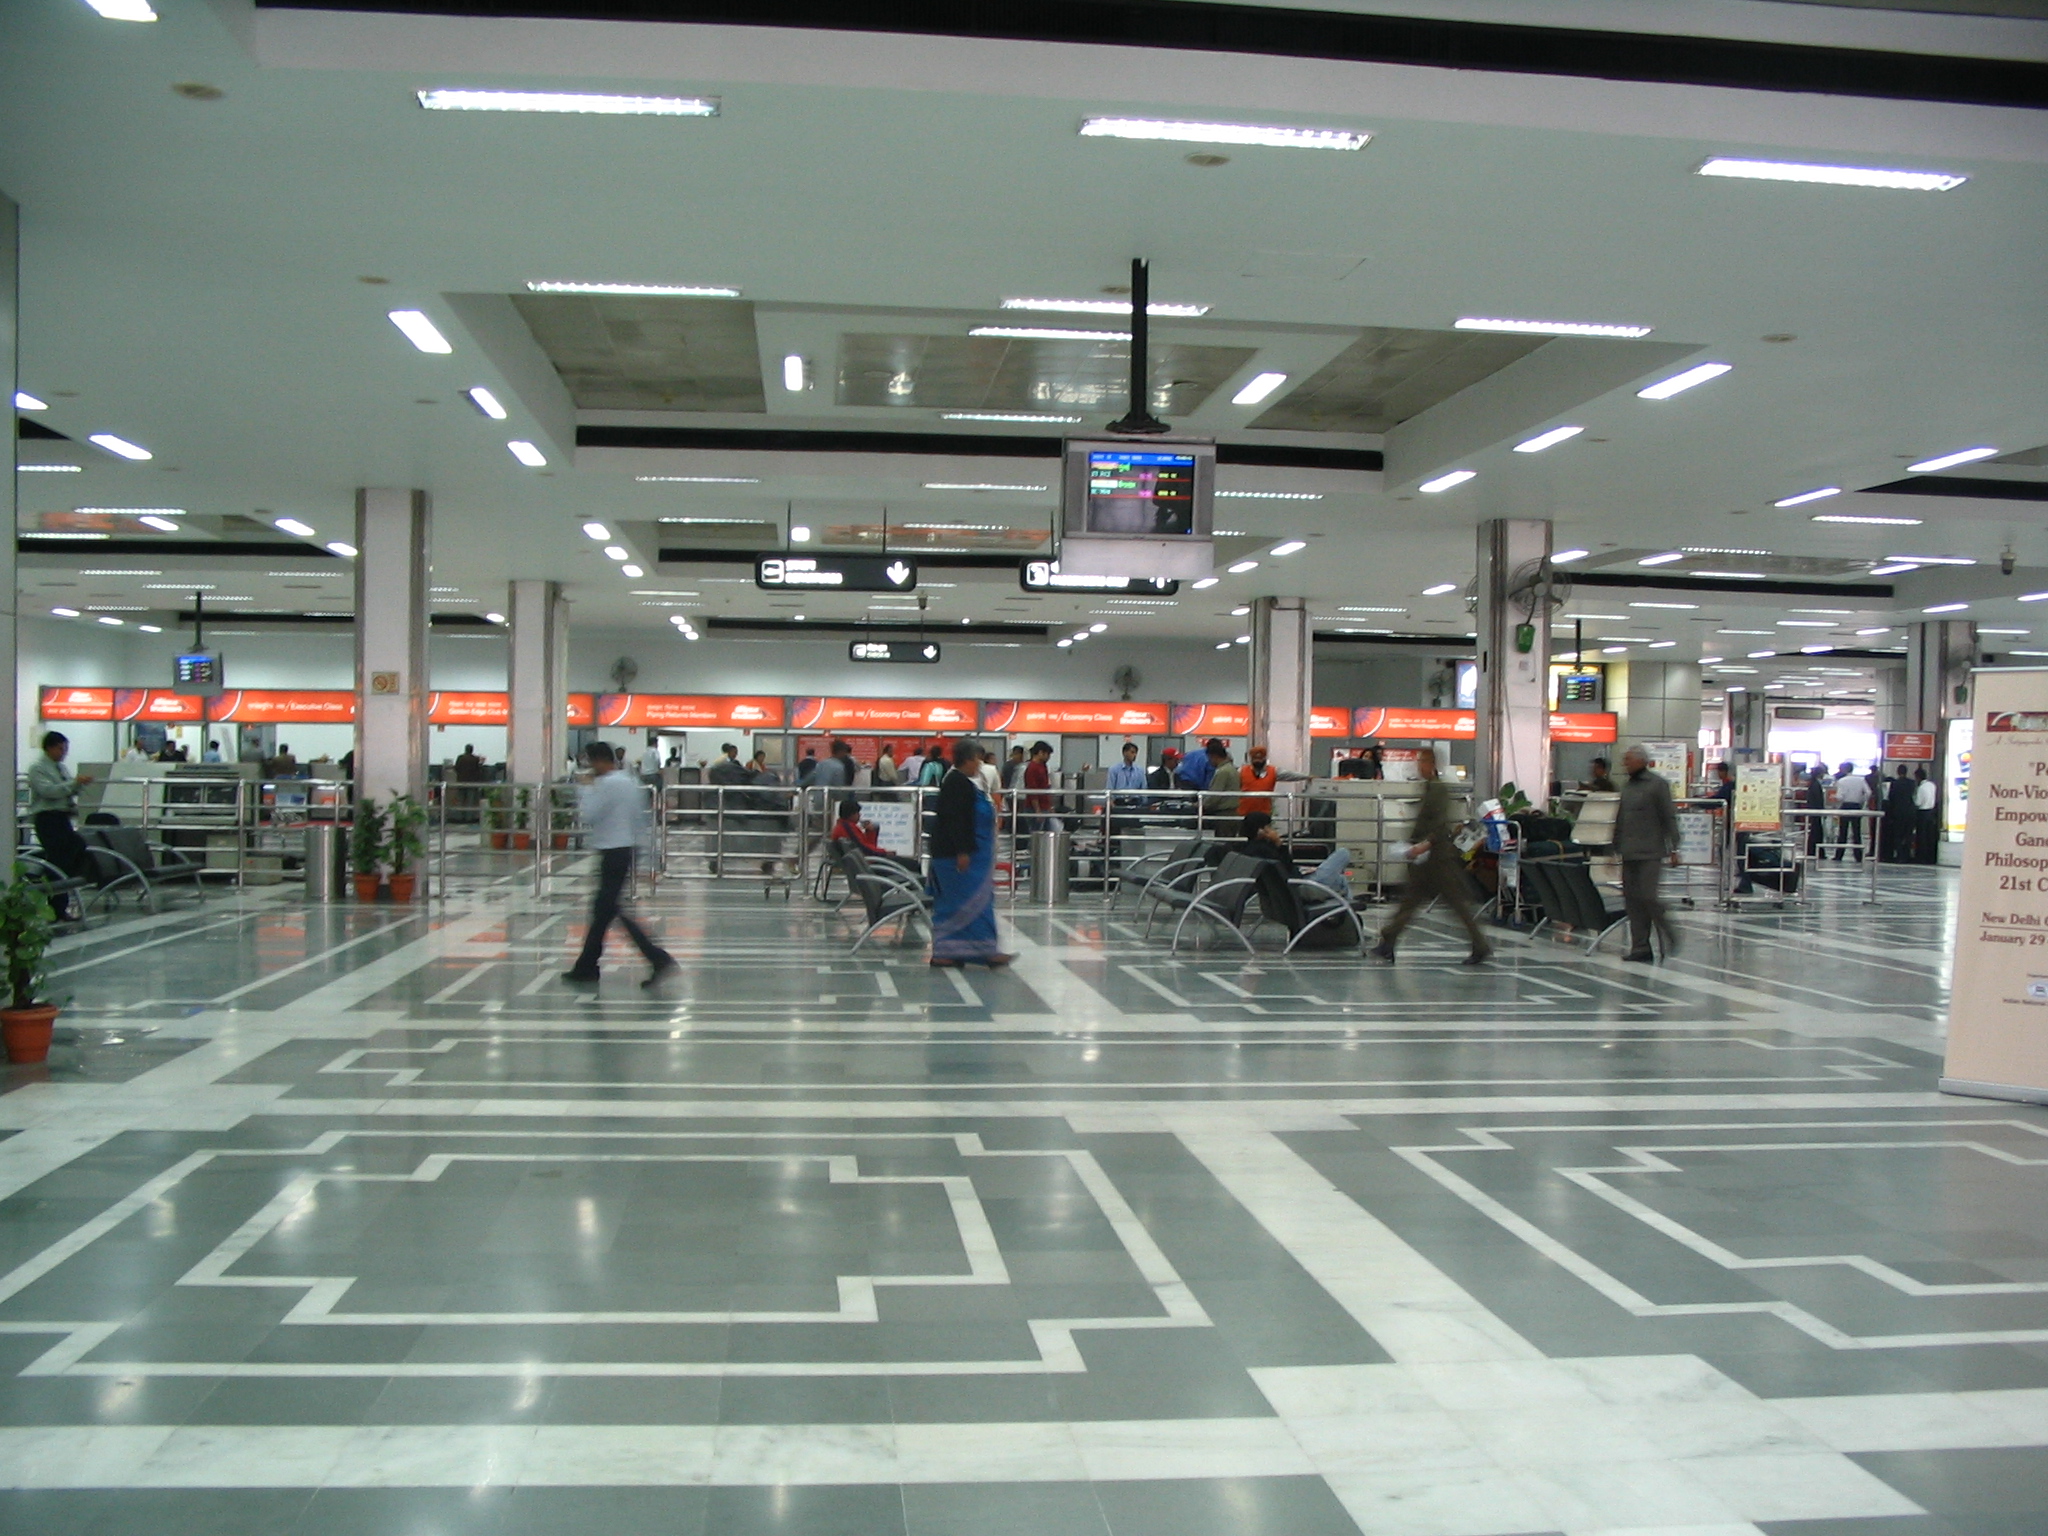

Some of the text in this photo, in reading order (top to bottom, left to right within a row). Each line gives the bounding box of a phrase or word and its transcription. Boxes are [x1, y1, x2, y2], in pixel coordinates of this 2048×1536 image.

[1989, 783, 2048, 800] Non-Vio
[1985, 851, 2048, 872] Philosop
[2000, 875, 2032, 891] 21st
[1981, 911, 2007, 924] New
[2009, 912, 2041, 926] Delhi
[1979, 930, 2045, 947] January 29
